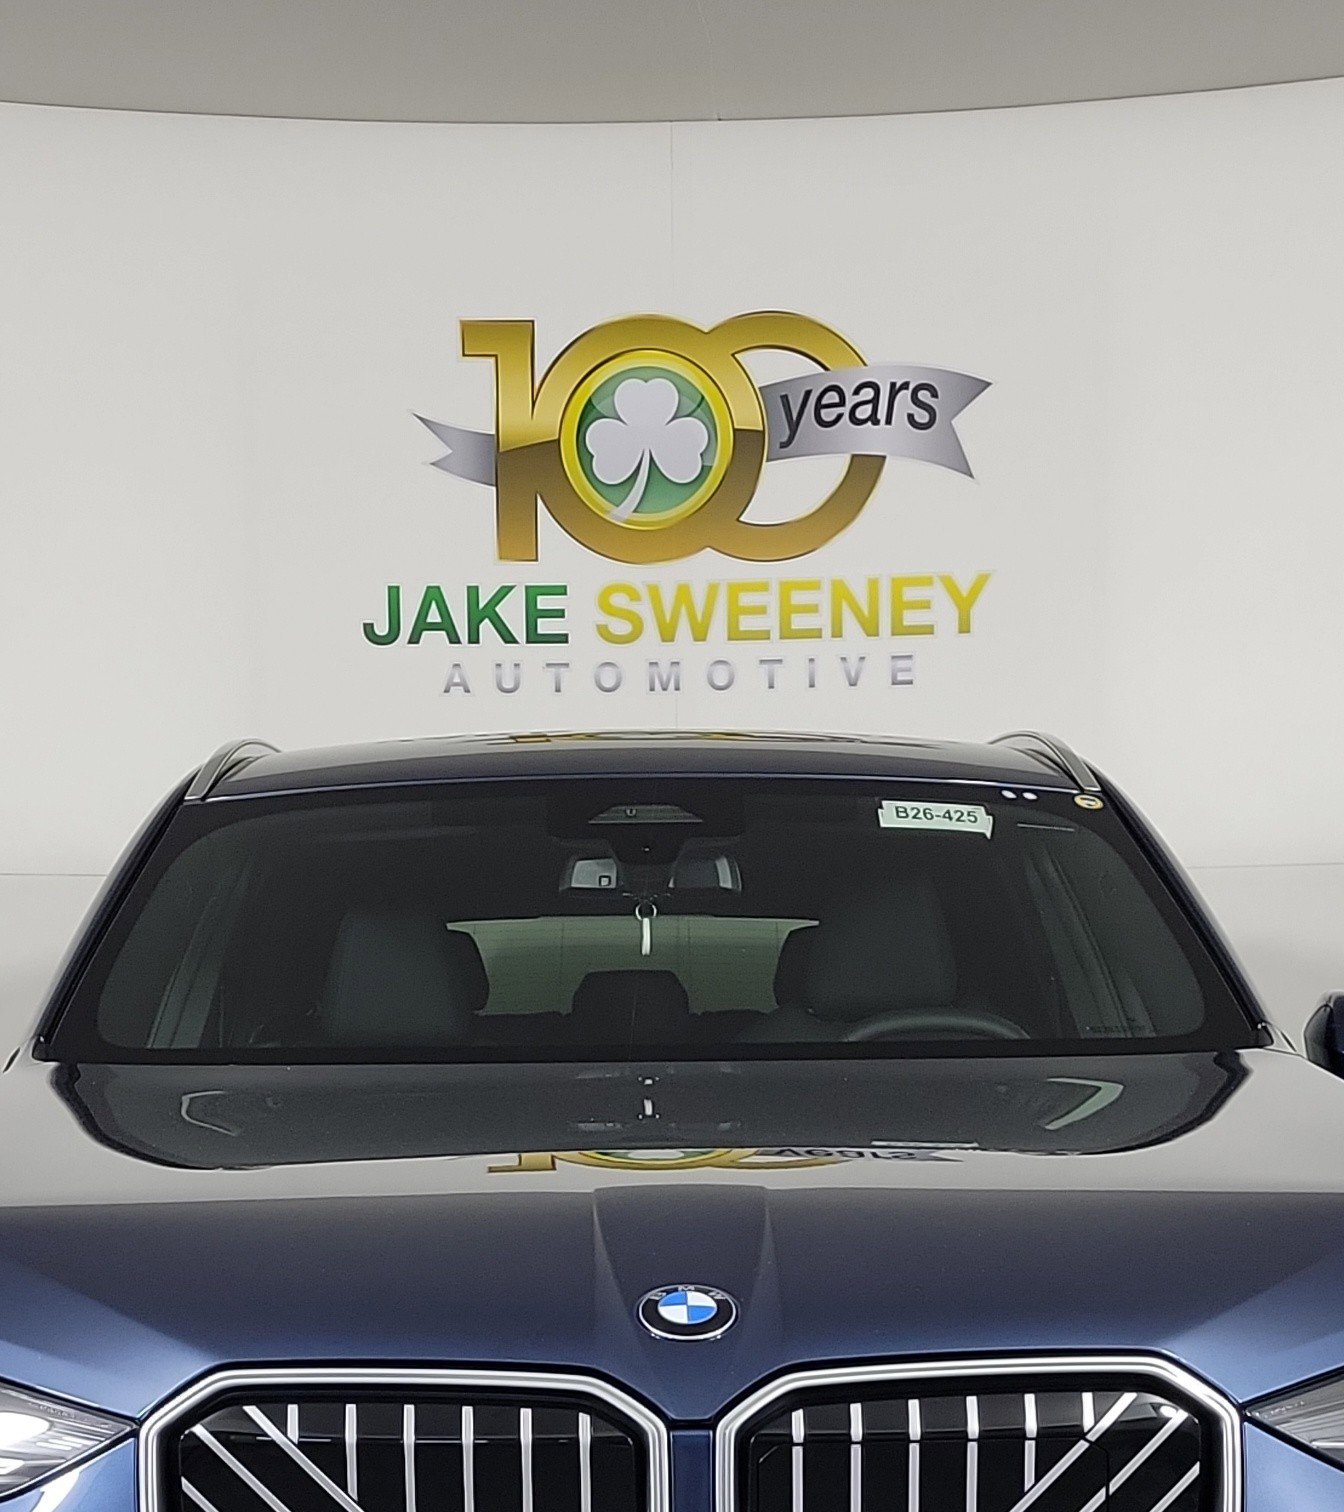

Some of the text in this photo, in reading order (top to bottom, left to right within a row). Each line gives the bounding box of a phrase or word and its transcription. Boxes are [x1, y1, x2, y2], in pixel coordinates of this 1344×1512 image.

[459, 310, 940, 565] 100 years
[362, 572, 992, 646] JAKE SWEENEY
[443, 653, 915, 694] AUTOMOTIVE
[894, 805, 978, 823] B26-425
